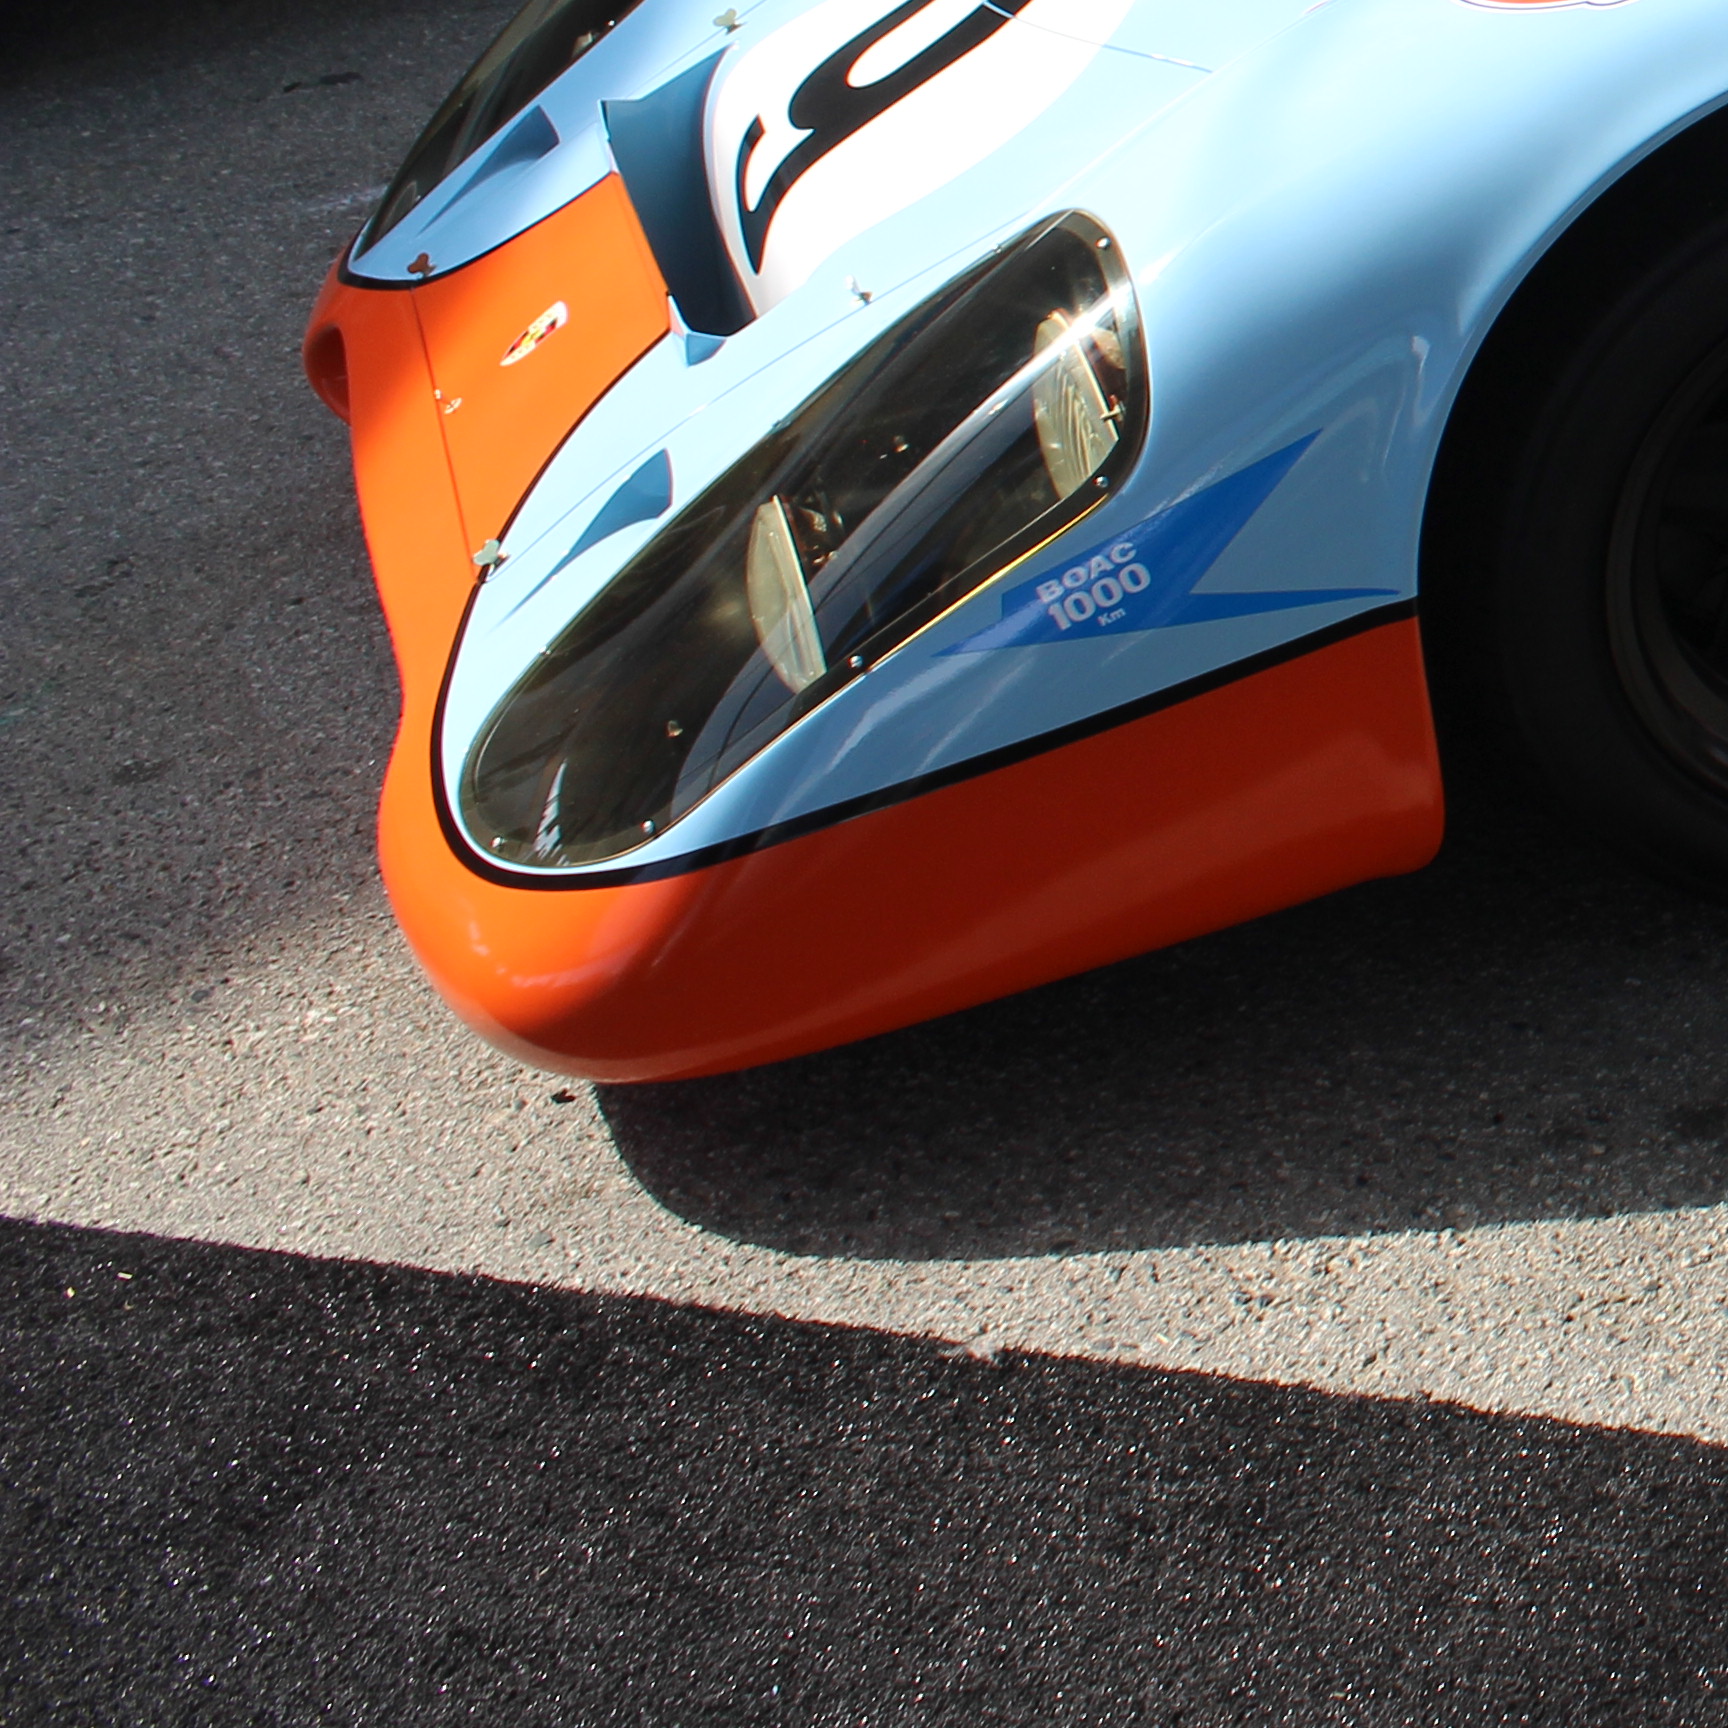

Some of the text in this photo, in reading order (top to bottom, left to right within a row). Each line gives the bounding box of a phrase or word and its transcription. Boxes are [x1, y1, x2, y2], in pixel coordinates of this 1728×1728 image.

[1034, 542, 1138, 604] BOAC
[1046, 562, 1152, 631] 1000
[1097, 606, 1127, 627] Km
